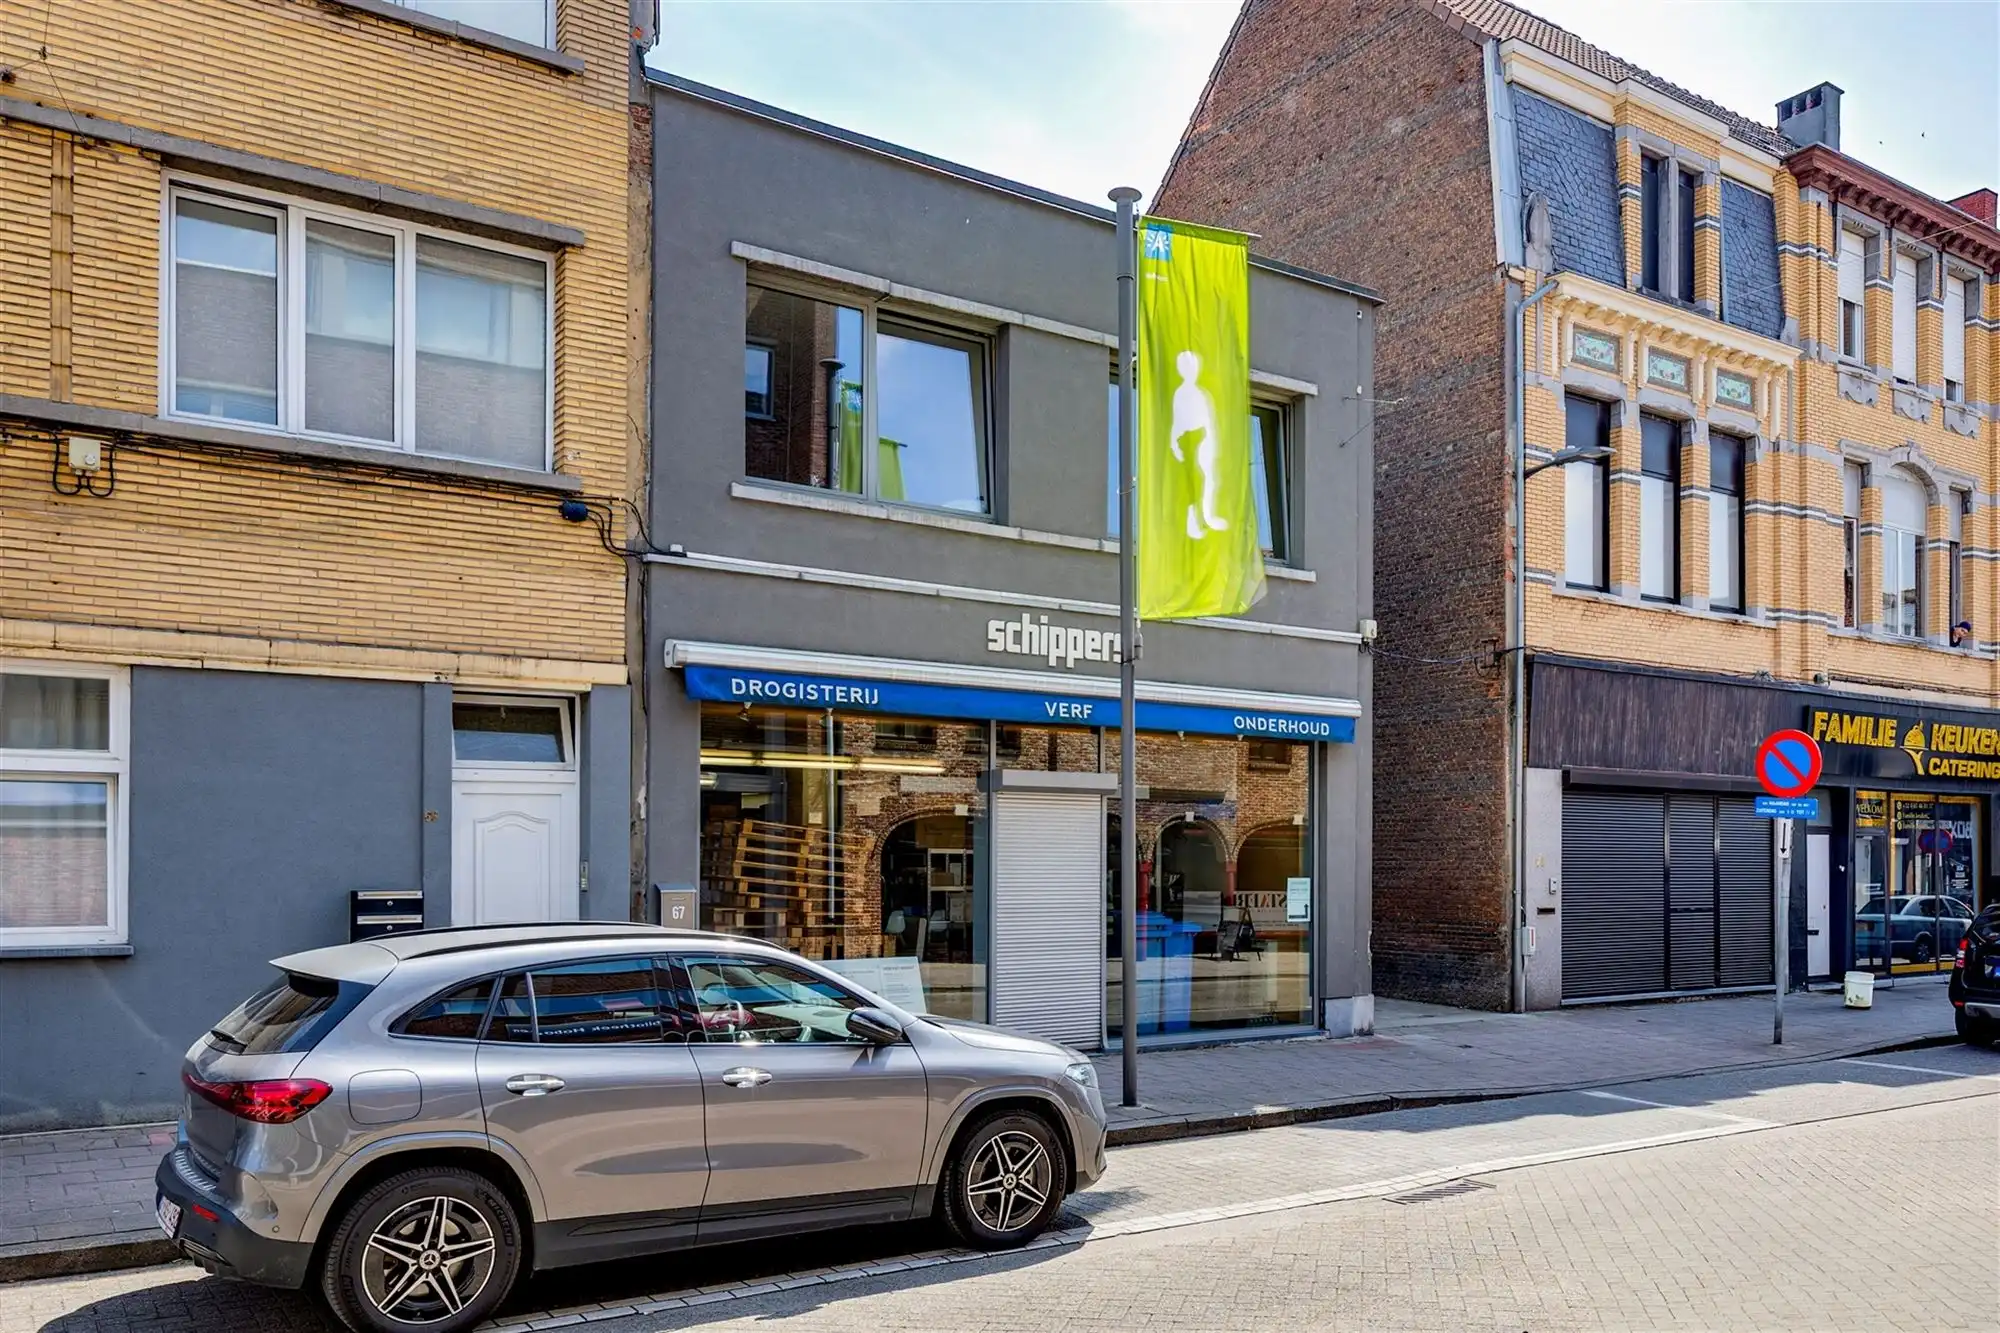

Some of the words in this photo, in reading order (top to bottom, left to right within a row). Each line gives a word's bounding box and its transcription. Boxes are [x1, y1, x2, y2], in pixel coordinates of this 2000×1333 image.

[731, 678, 879, 705] DROGISTERIJ
[1044, 701, 1093, 719] VERF
[1233, 715, 1330, 736] ONDERHOUD
[1812, 711, 1898, 748] FAMILIE
[1928, 757, 2000, 779] CATERING
[672, 905, 685, 920] 67
